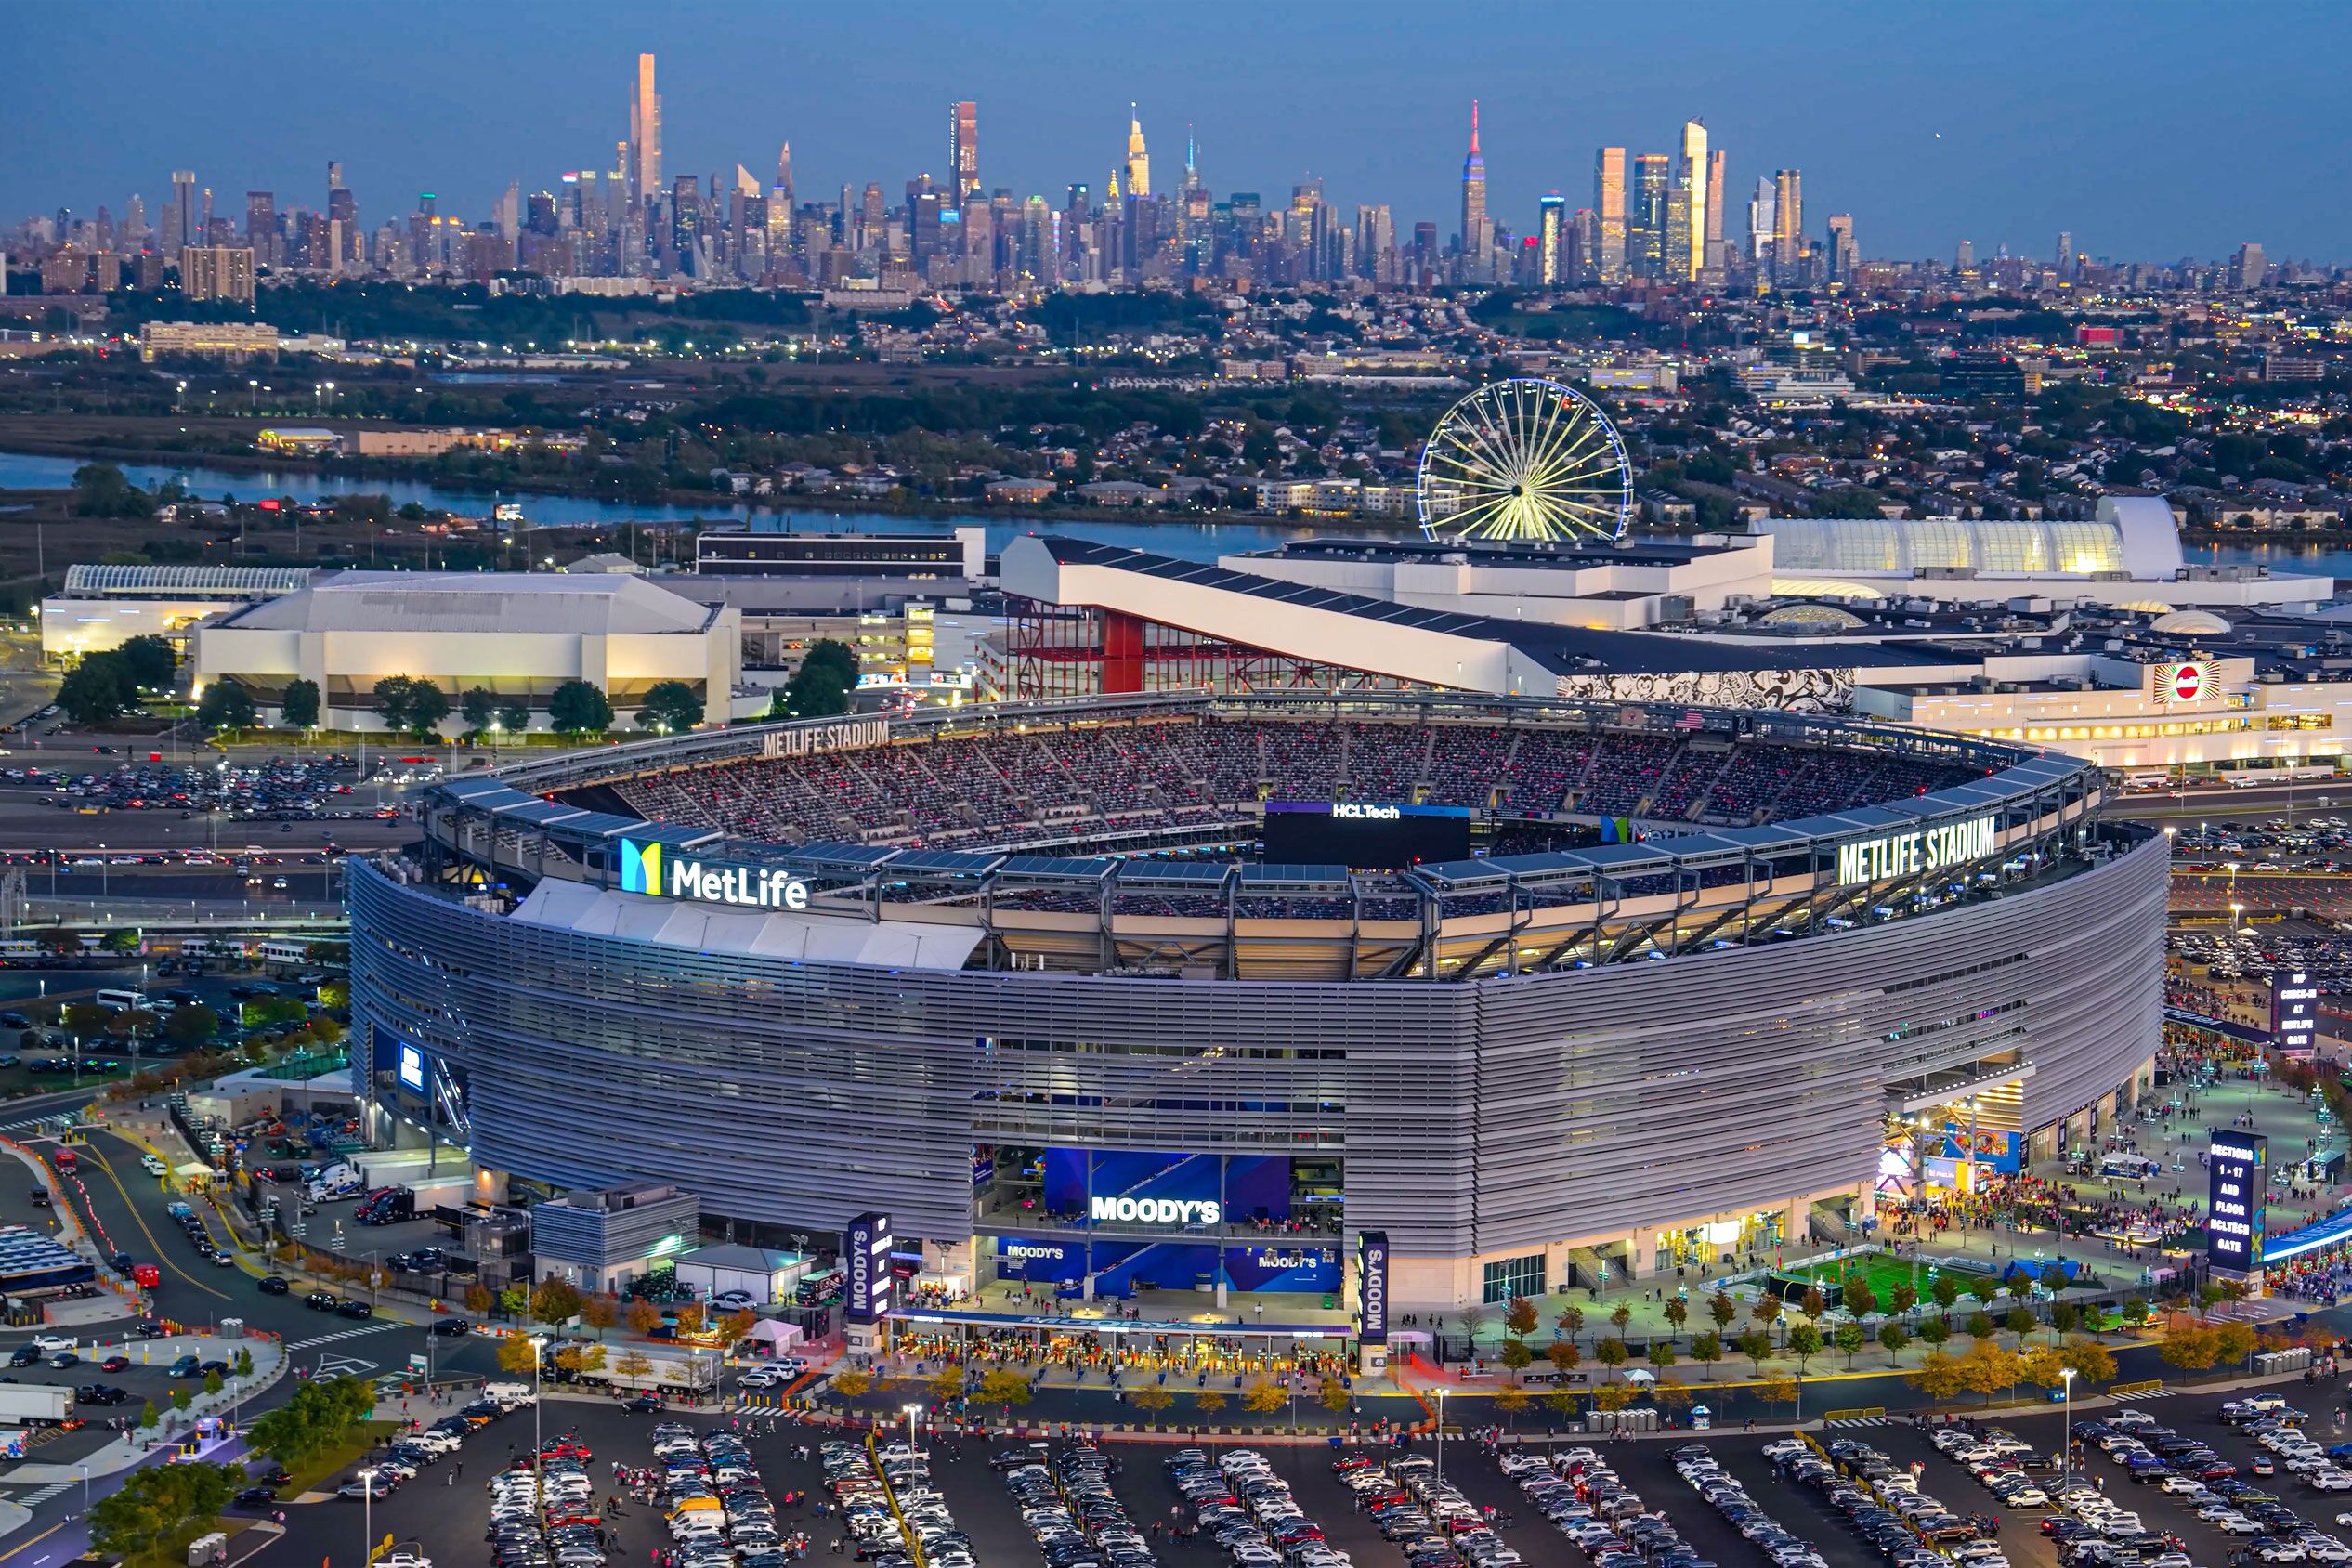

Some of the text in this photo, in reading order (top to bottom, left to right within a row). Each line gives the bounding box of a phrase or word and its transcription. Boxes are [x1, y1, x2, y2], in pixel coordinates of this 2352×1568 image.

[764, 721, 889, 757] METLIFE STADIUM
[1333, 804, 1400, 819] HCLTech
[1839, 816, 1994, 885] METLIFE STADIUM
[673, 859, 807, 909] MetLife
[2293, 1005, 2304, 1013] AT
[2287, 1035, 2307, 1044] GATE
[2211, 1143, 2253, 1160] SECTIONS
[2219, 1164, 2225, 1175] 1
[2233, 1167, 2243, 1178] 17
[2221, 1183, 2239, 1196] AND
[1091, 1196, 1220, 1224] MOODY'S
[2215, 1200, 2244, 1216] FLOOR
[2211, 1218, 2250, 1235] HCLTECH
[1007, 1245, 1064, 1260] MOODY'S
[2217, 1238, 2241, 1252] GATE
[853, 1230, 868, 1310] MOODY'S
[1367, 1249, 1383, 1330] MOODY'S
[1022, 1316, 1214, 1330] MOODY'S
